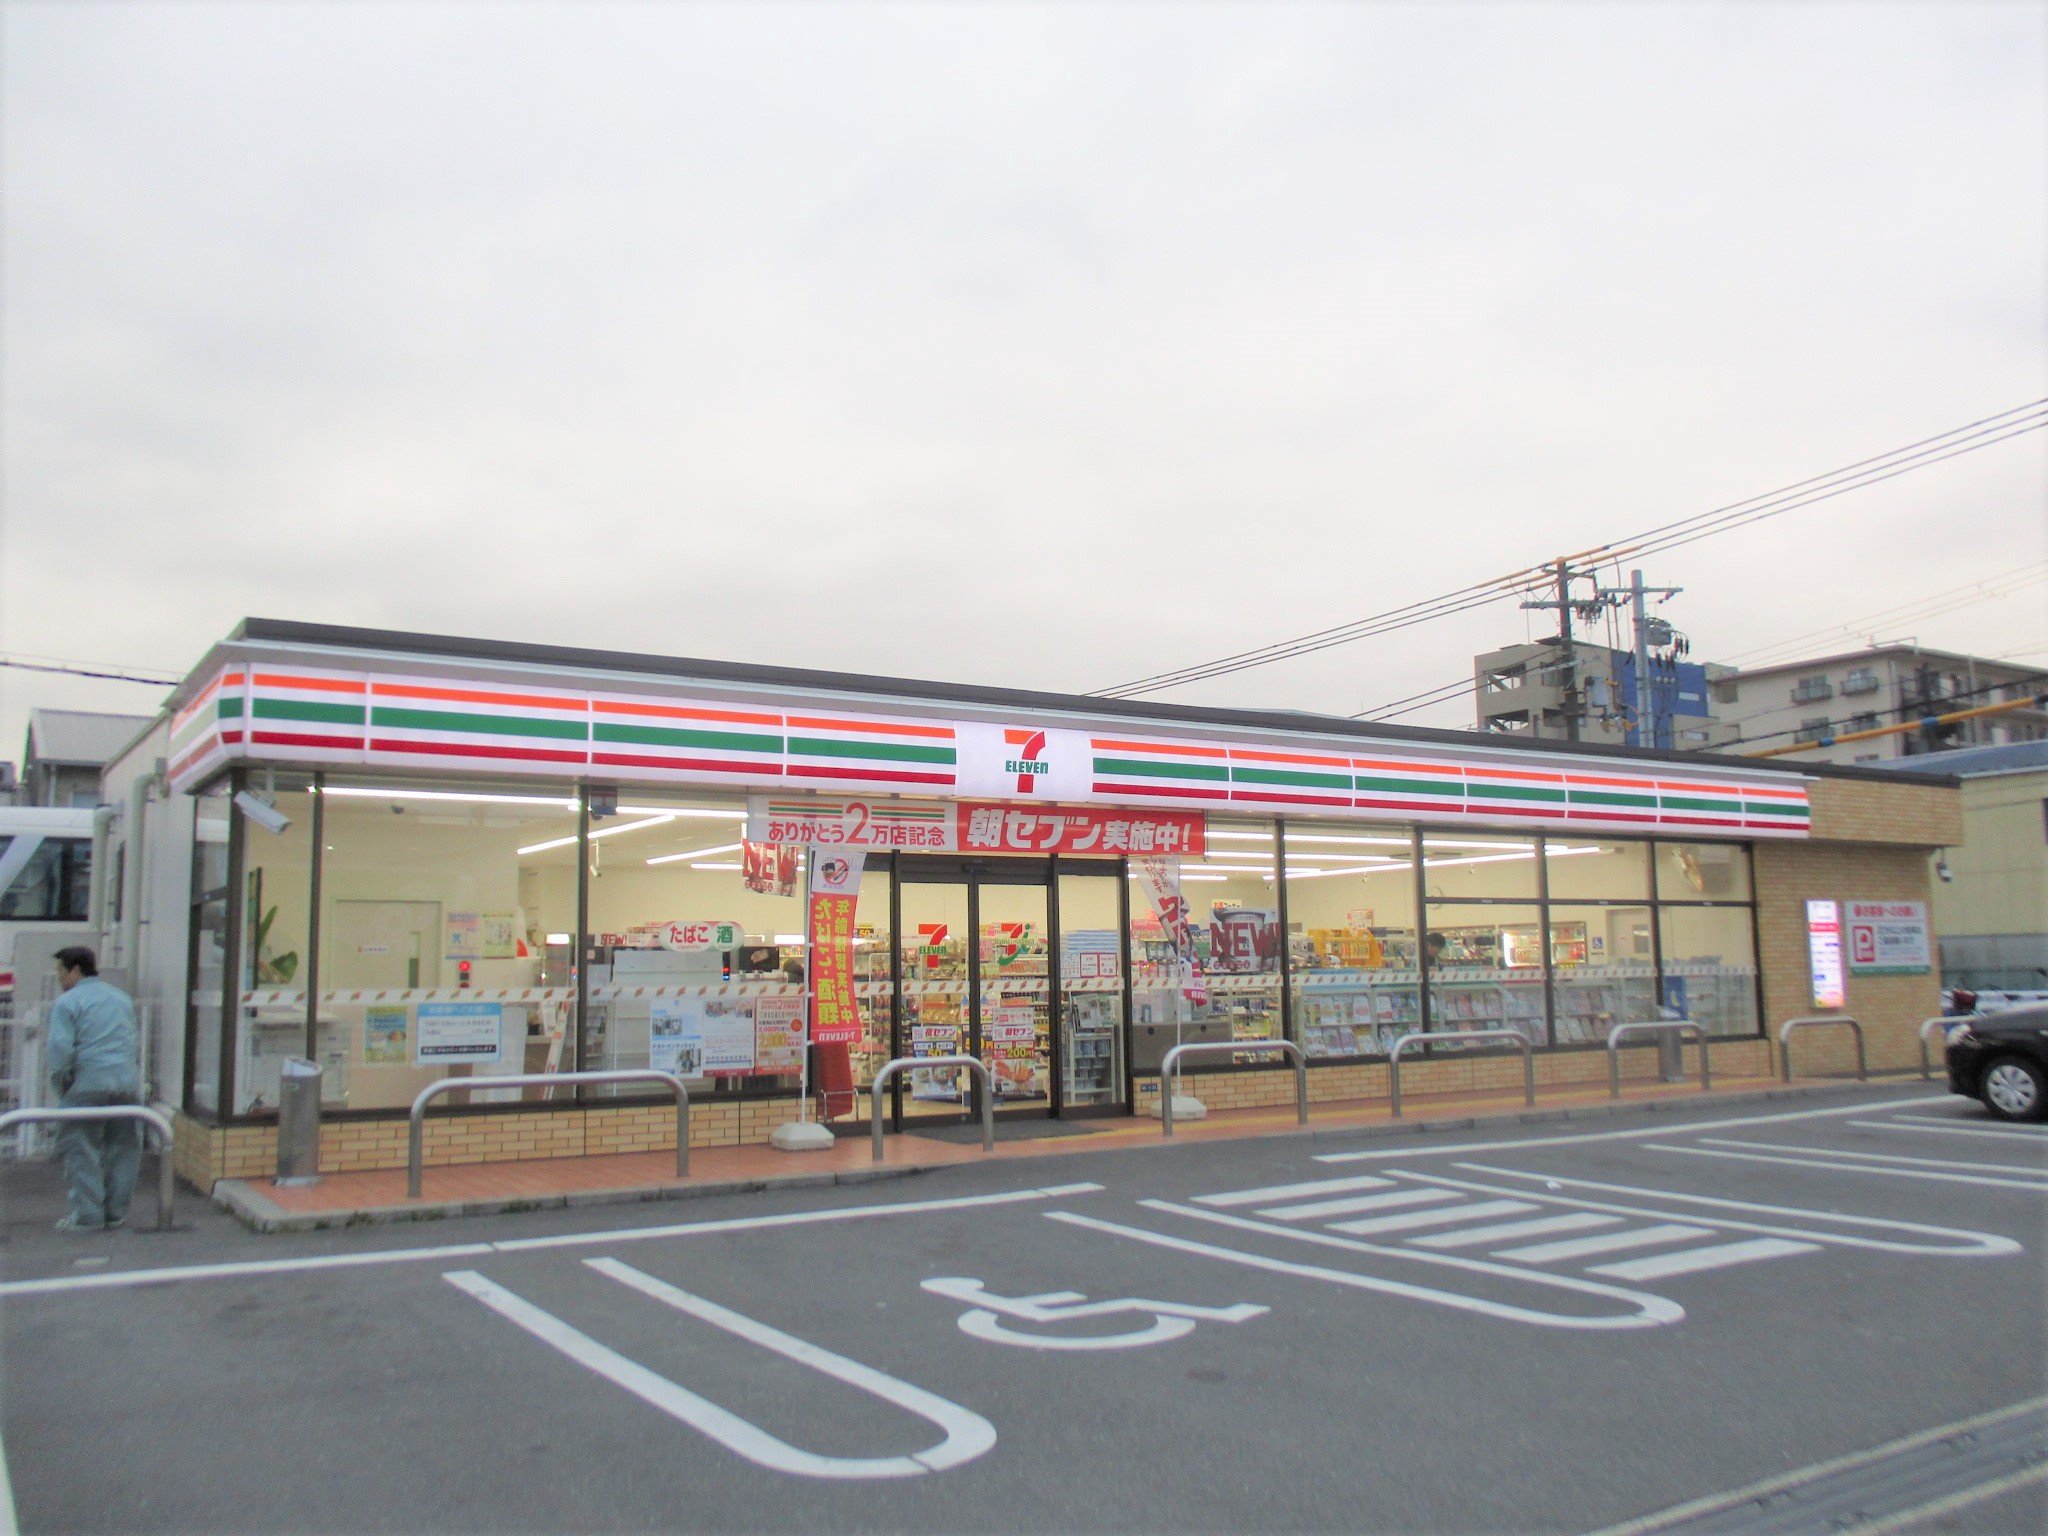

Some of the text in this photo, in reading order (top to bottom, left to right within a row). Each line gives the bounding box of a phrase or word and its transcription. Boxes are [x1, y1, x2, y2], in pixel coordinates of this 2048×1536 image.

[1004, 729, 1046, 793] 7
[768, 802, 945, 846] ありがとう2万店記念
[670, 925, 733, 945] たばこ 酒
[918, 923, 948, 968] 7
